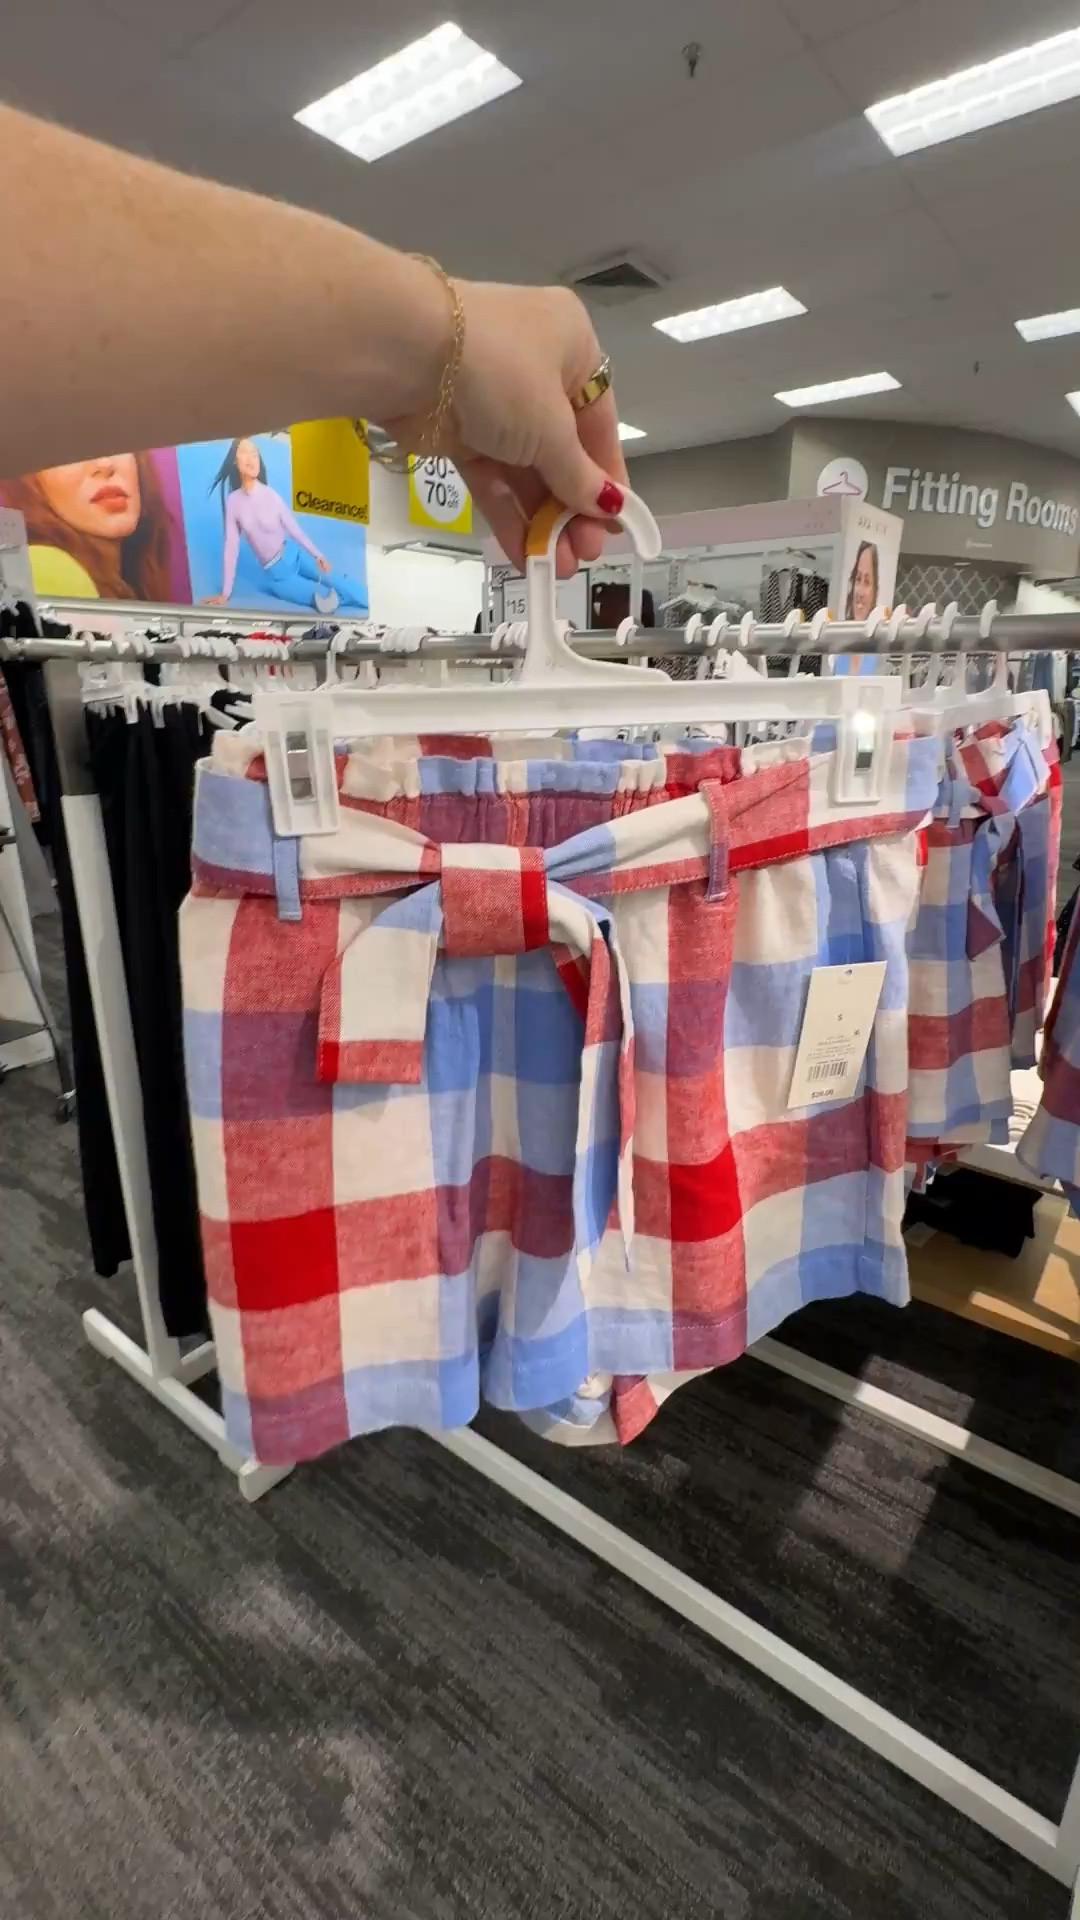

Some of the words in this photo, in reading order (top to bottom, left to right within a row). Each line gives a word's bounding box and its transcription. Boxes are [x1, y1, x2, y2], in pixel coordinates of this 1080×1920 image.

[295, 490, 368, 519] Clearance!
[882, 466, 999, 528] Fitting
[1005, 481, 1079, 535] Rooms
